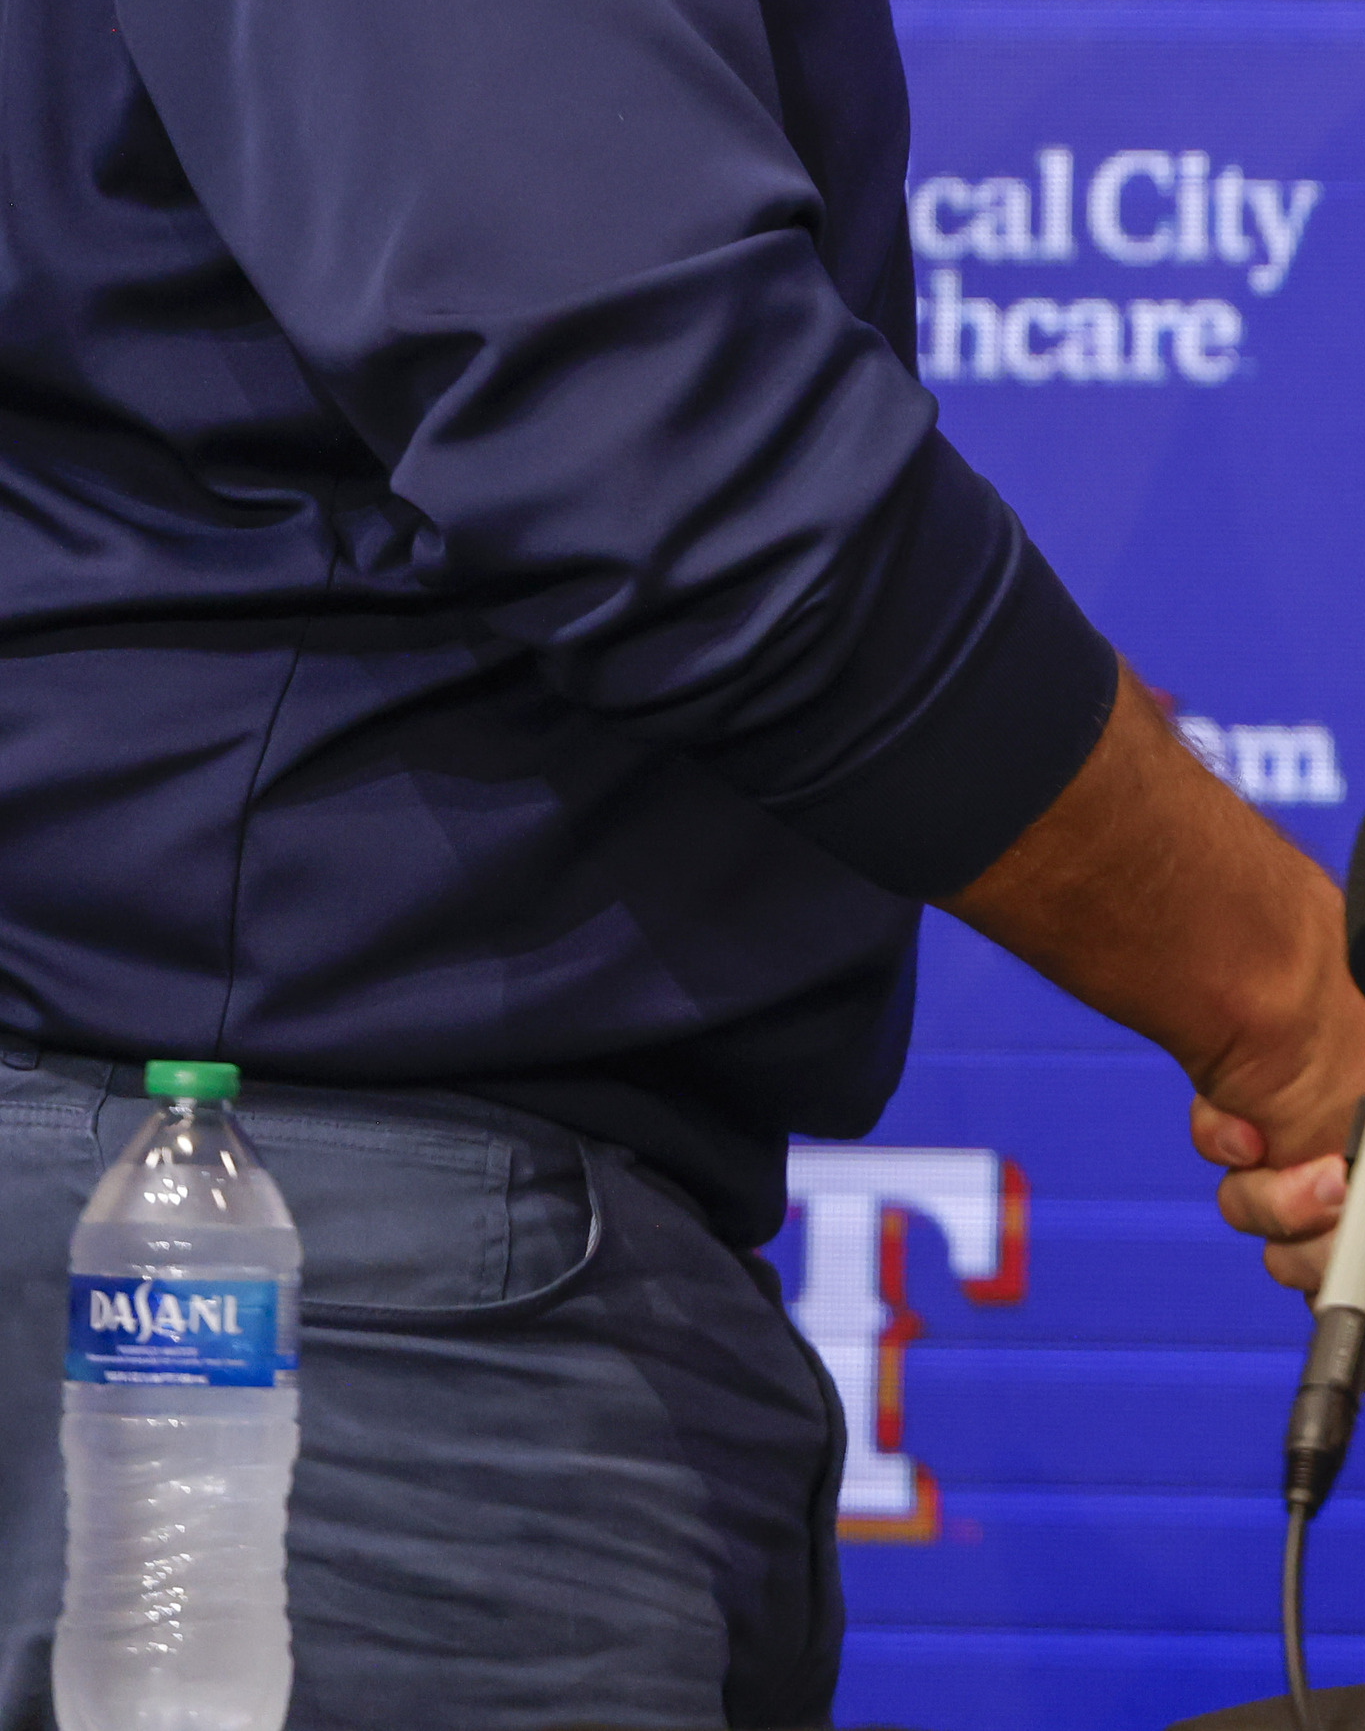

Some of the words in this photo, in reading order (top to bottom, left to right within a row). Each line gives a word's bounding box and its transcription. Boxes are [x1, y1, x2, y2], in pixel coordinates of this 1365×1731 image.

[1084, 148, 1323, 294] City
[917, 268, 1246, 386] hcare
[90, 1280, 243, 1343] DASANI
